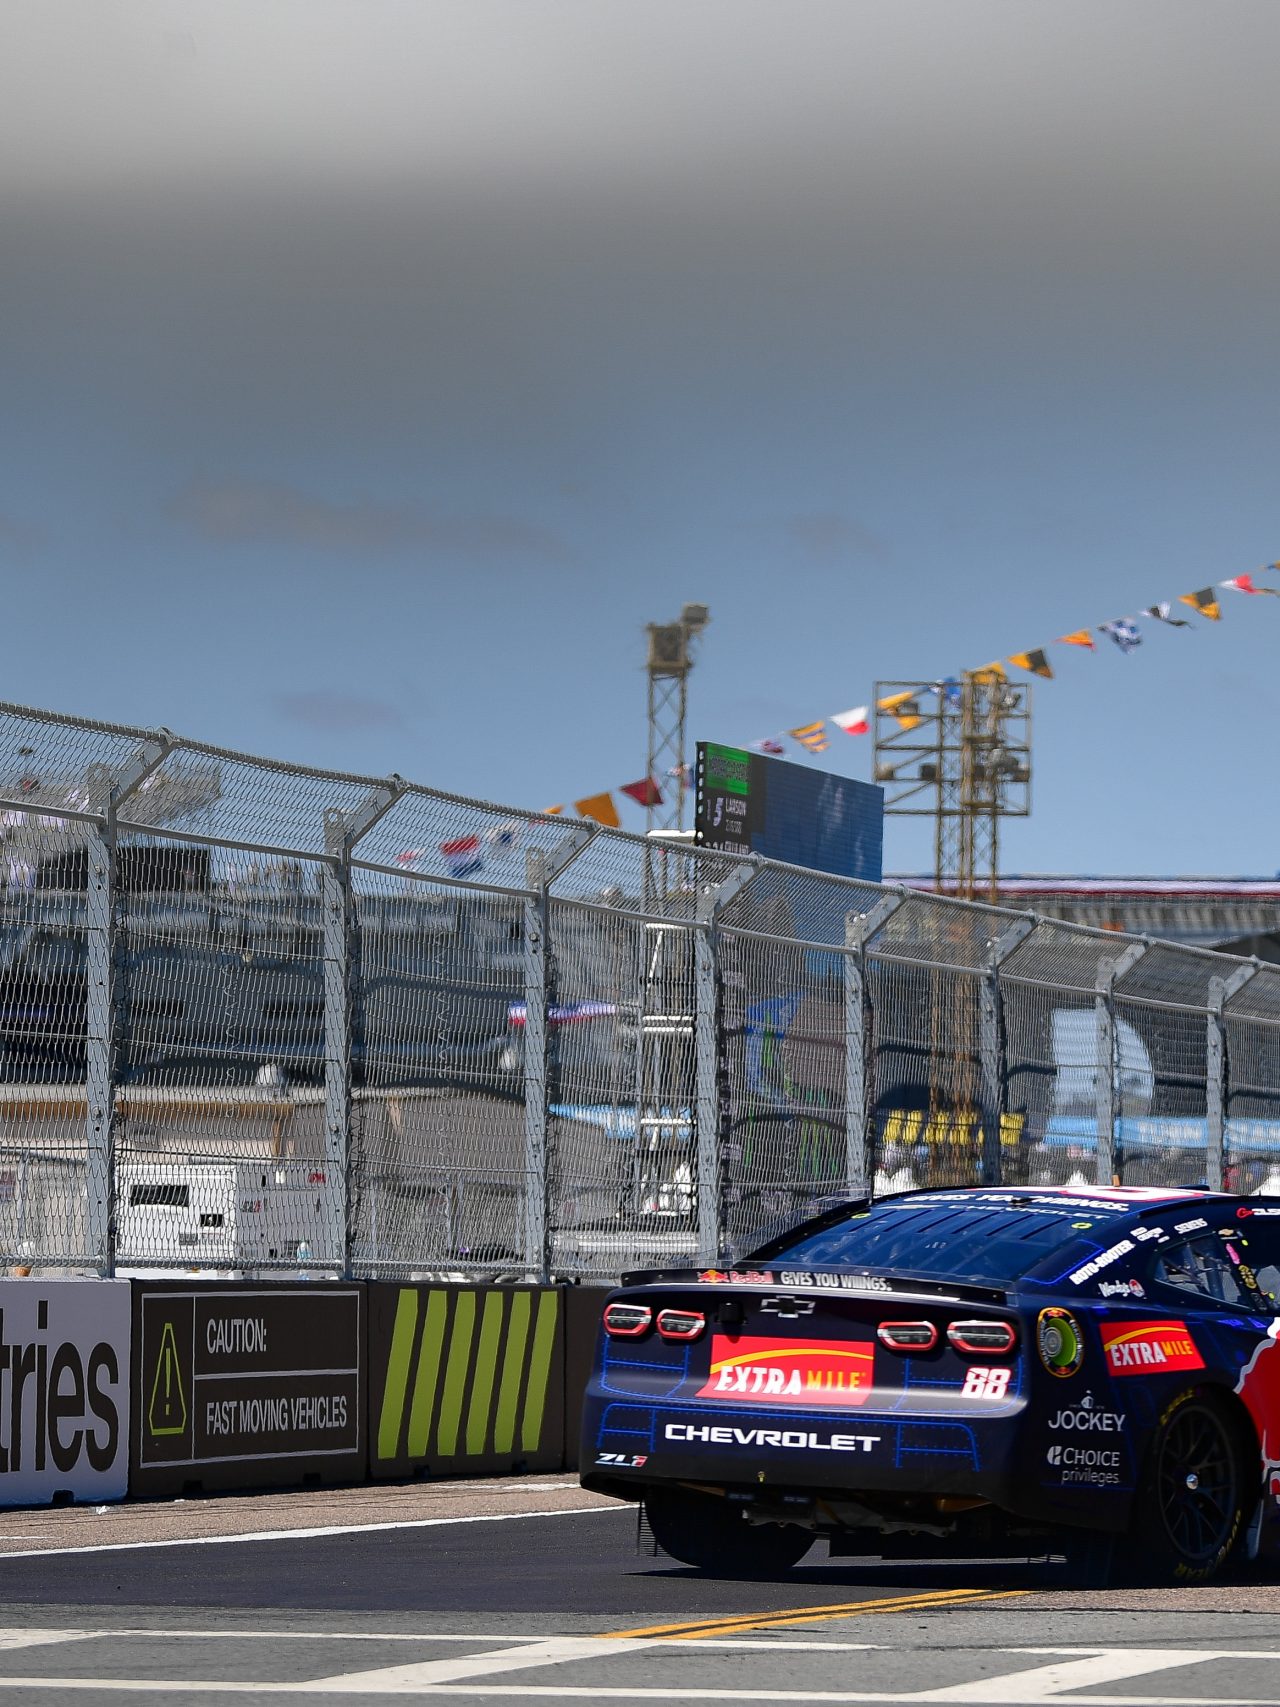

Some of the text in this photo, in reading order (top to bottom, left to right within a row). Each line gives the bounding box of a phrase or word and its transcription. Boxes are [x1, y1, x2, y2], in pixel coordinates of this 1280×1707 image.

[948, 1204, 1111, 1220] CHEVROLET
[1069, 1239, 1136, 1285] ROTO-ROOTER
[780, 1271, 814, 1286] GIVES
[814, 1272, 840, 1288] YOU
[206, 1318, 267, 1354] CAUTION:
[1110, 1340, 1194, 1367] EXTRA MILE
[713, 1365, 861, 1396] EXTRA MILE
[961, 1366, 1012, 1400] 88
[206, 1395, 348, 1436] FAST MOVING VEHICLES
[1047, 1410, 1126, 1432] JOCKEY
[664, 1423, 881, 1452] CHEVROLET
[1063, 1447, 1120, 1467] CHOICE
[1061, 1467, 1121, 1487] privileges
